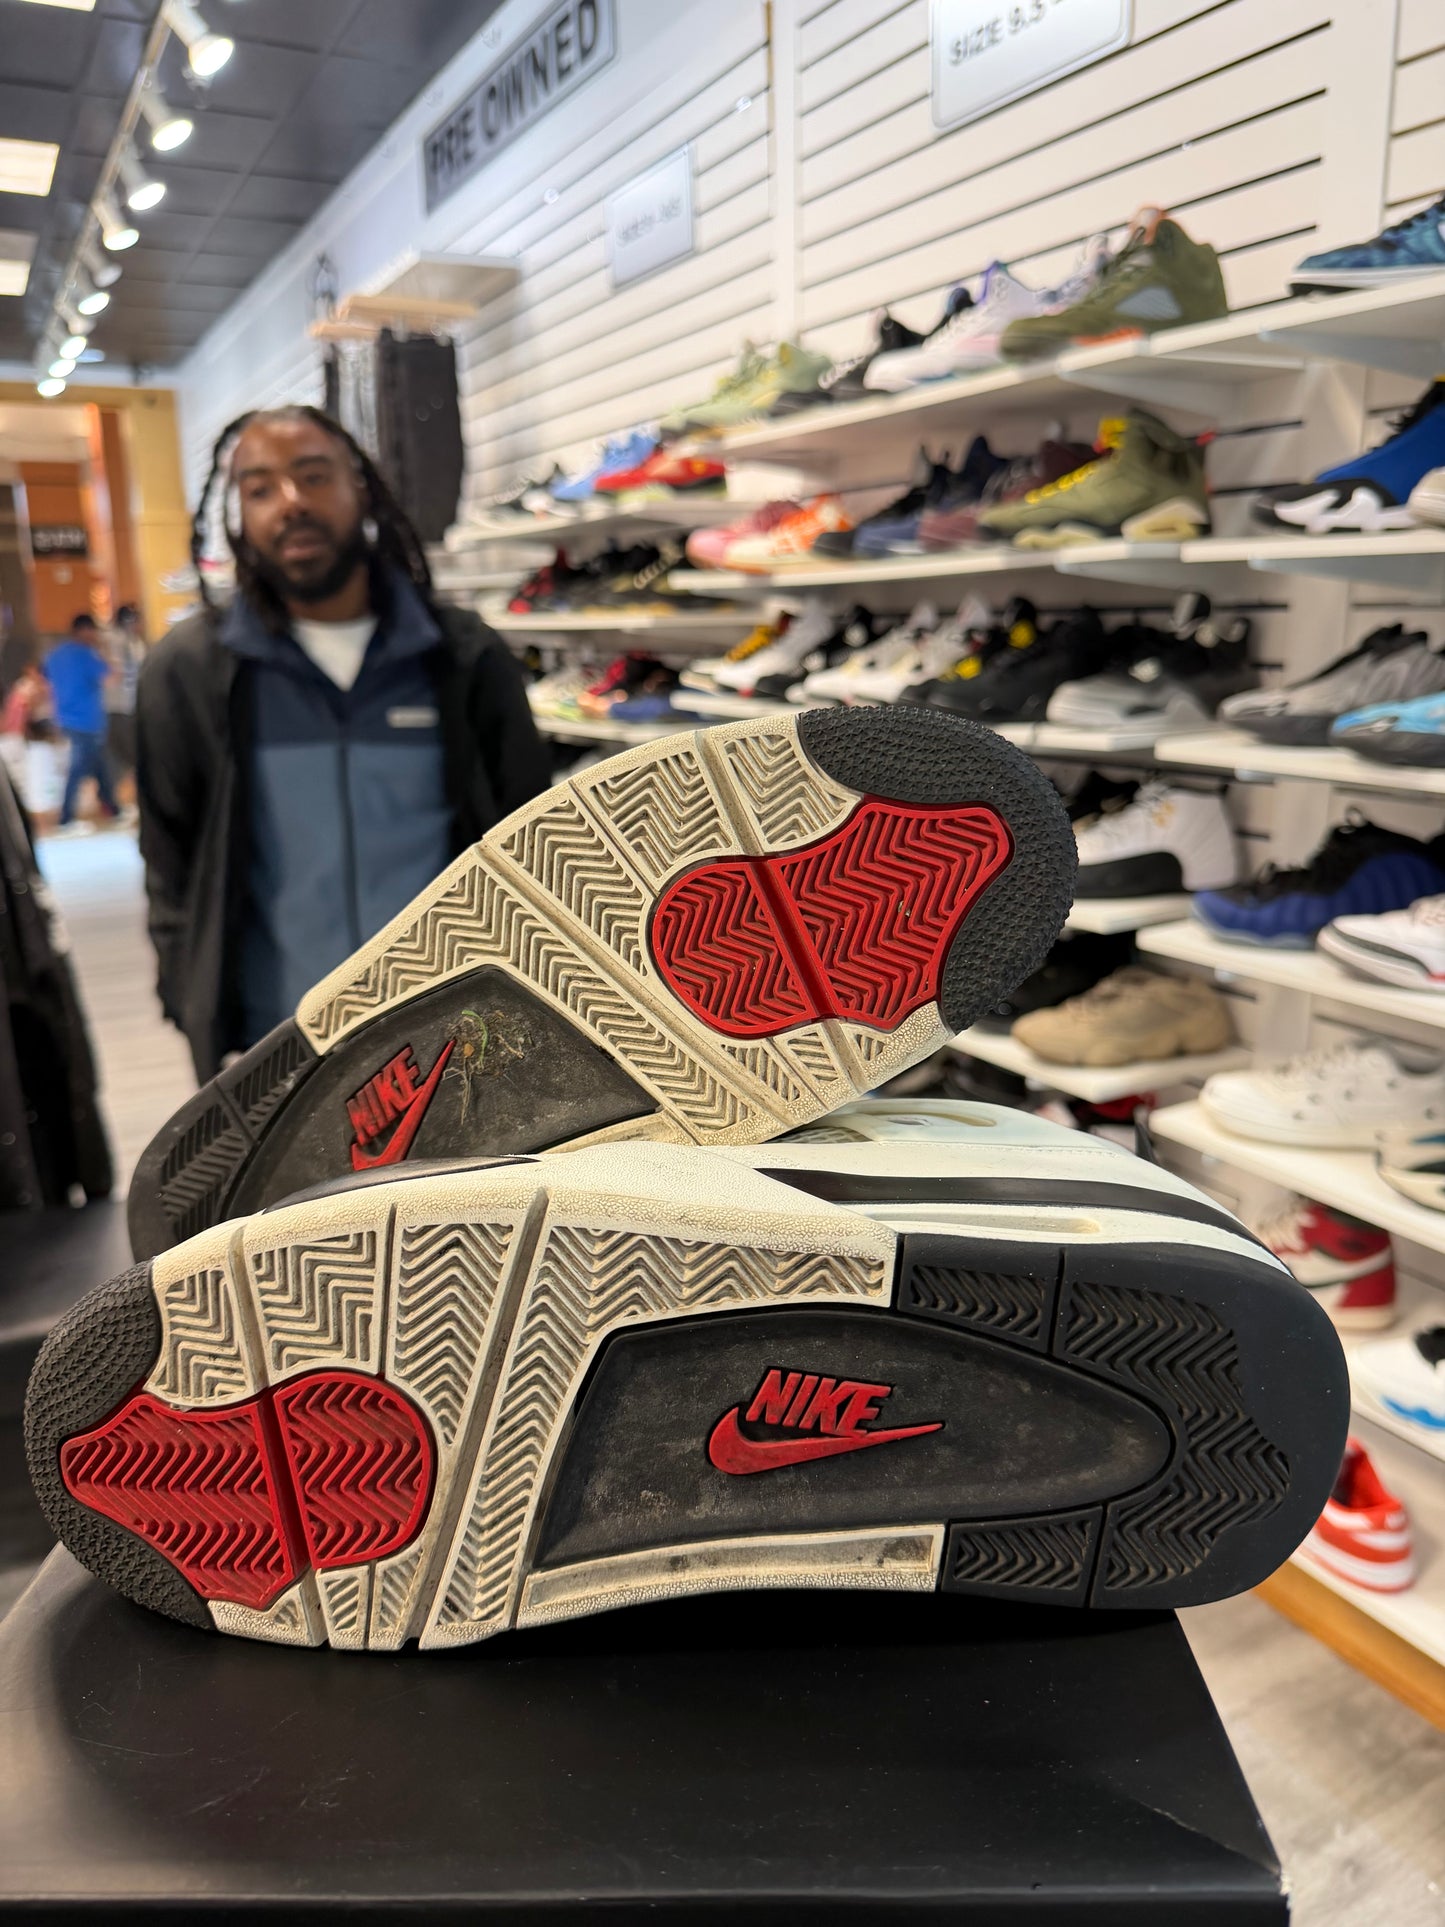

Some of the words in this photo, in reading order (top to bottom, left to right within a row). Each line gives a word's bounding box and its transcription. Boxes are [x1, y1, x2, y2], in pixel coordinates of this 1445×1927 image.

[949, 16, 1003, 67] SIZE
[430, 106, 476, 178] PRE
[480, 0, 598, 143] OWNED
[346, 1046, 421, 1147] NIKE
[745, 1368, 892, 1437] NIKE
